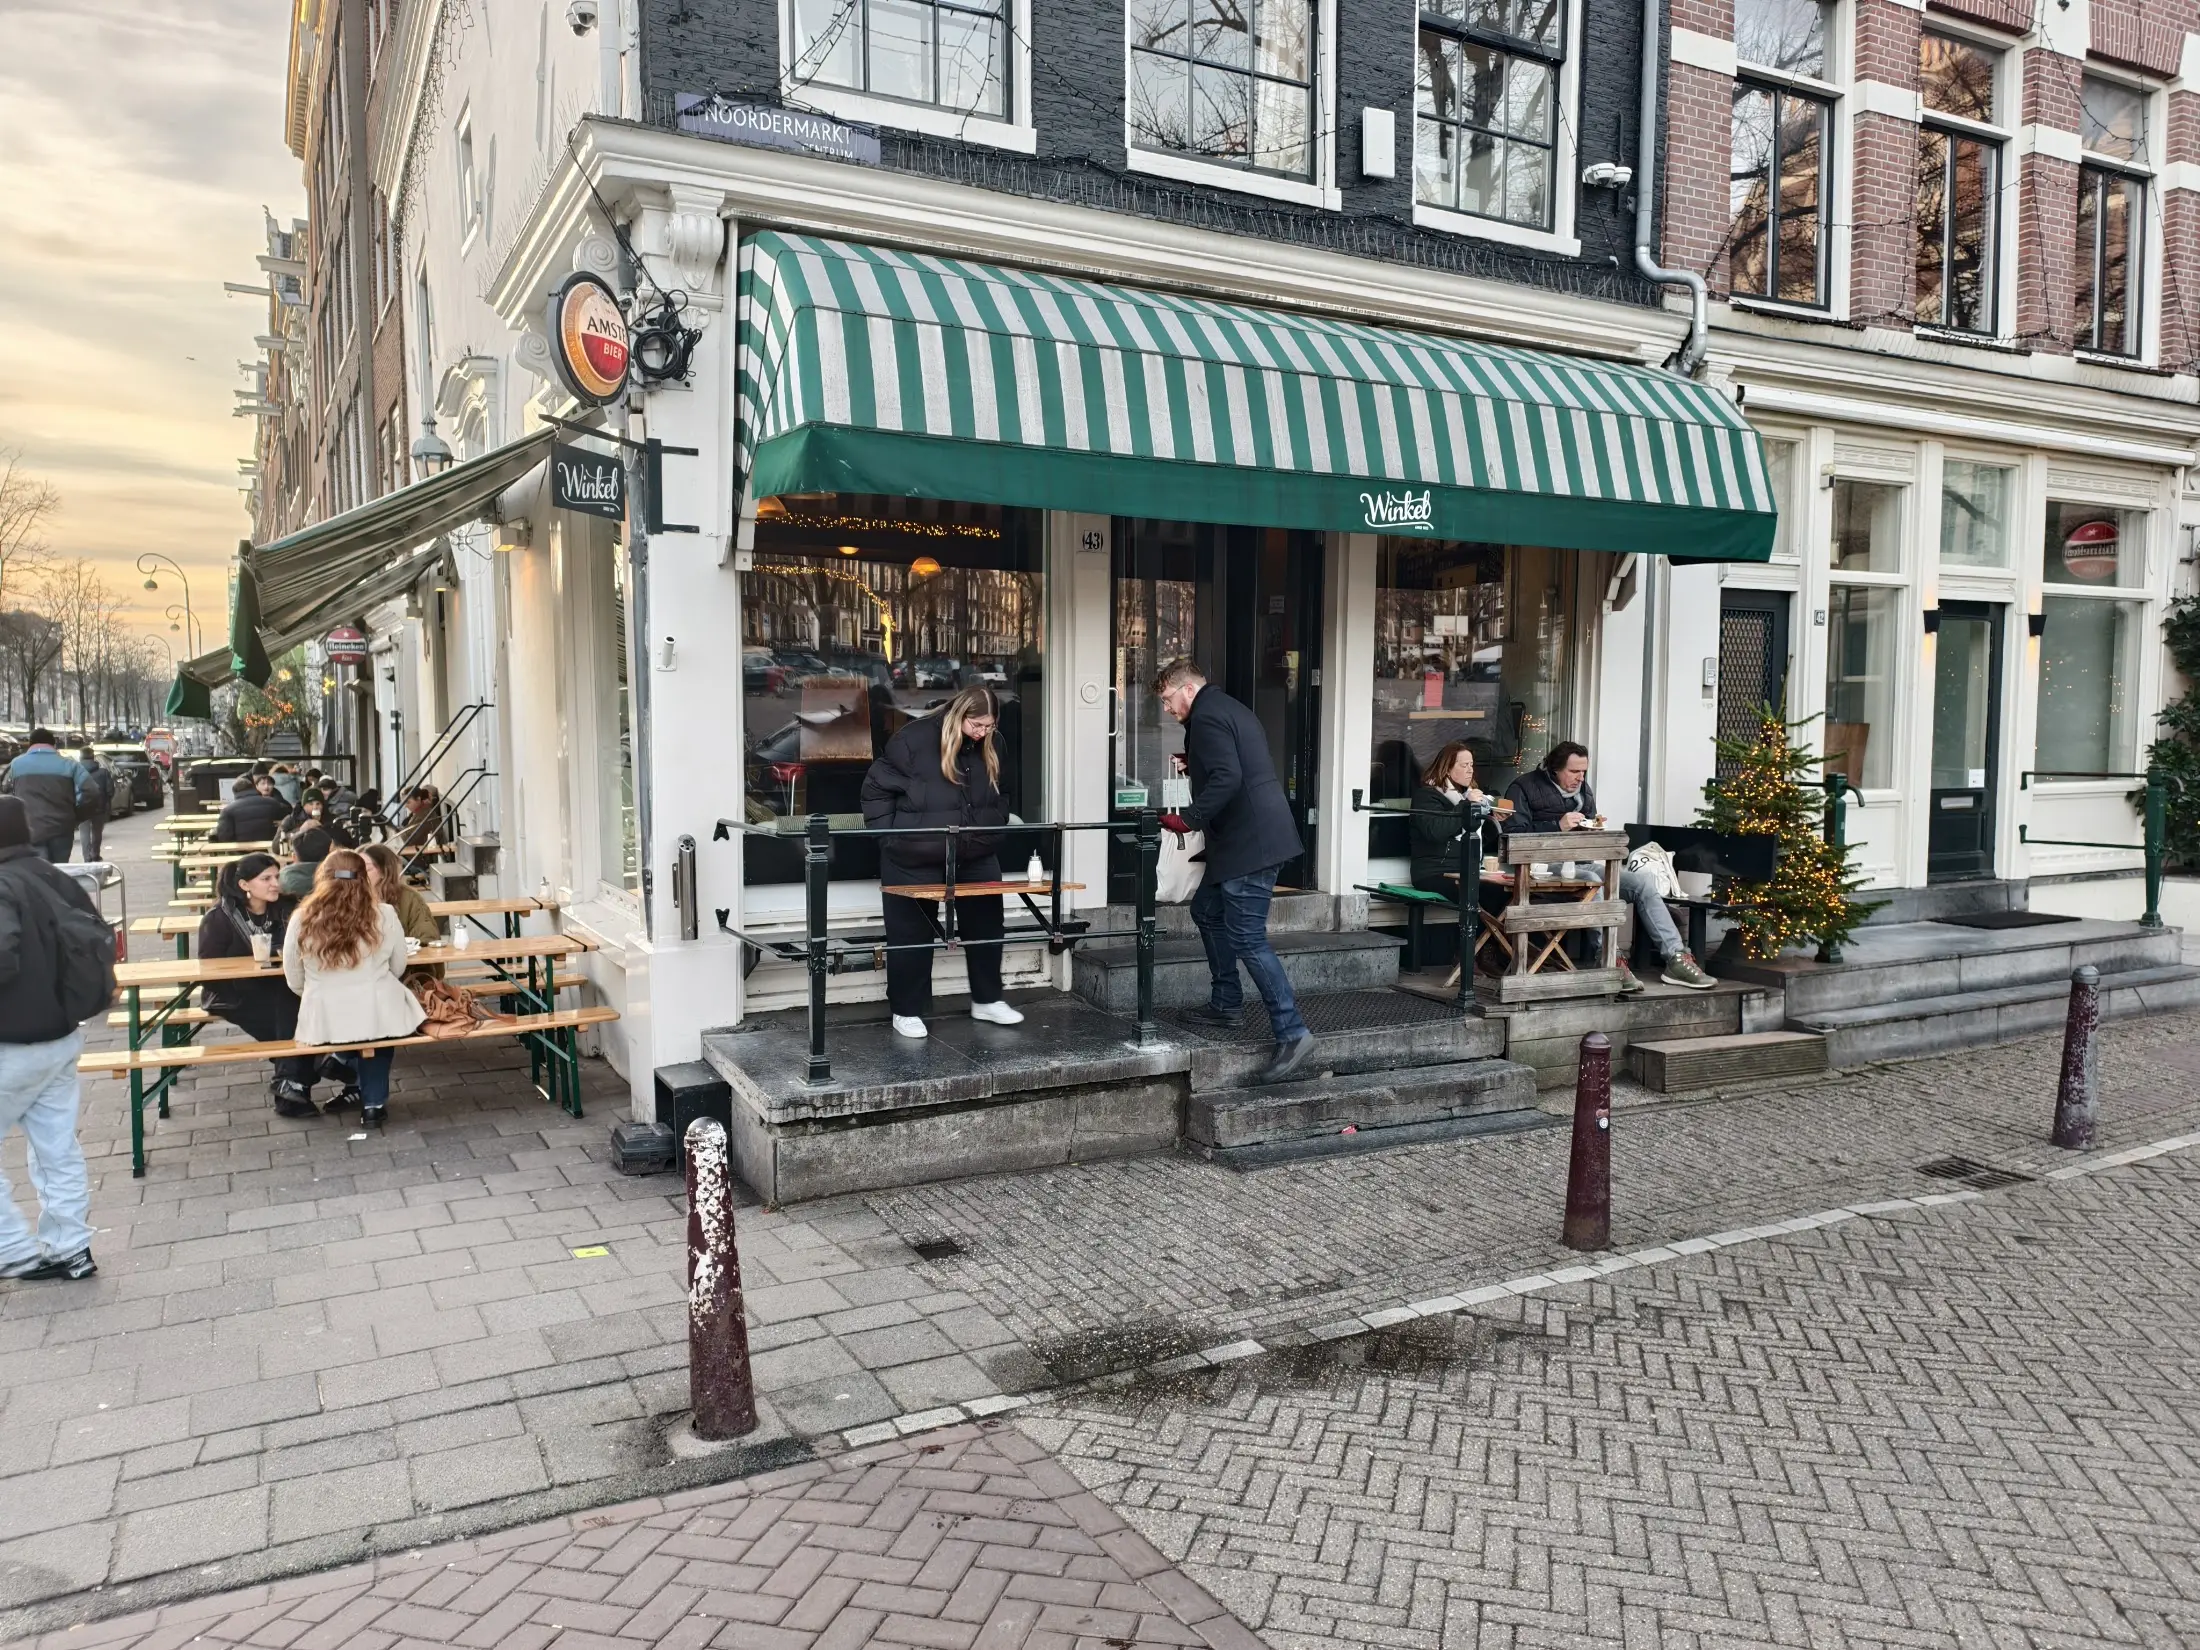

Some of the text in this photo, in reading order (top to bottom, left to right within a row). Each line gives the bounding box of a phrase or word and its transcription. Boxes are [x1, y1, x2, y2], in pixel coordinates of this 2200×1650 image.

[705, 106, 853, 144] NOORDERMARKT
[587, 316, 627, 343] AMSTE
[603, 342, 622, 360] BIER
[557, 462, 619, 501] Winkel
[1360, 490, 1431, 522] Winkel
[1085, 531, 1100, 549] 43
